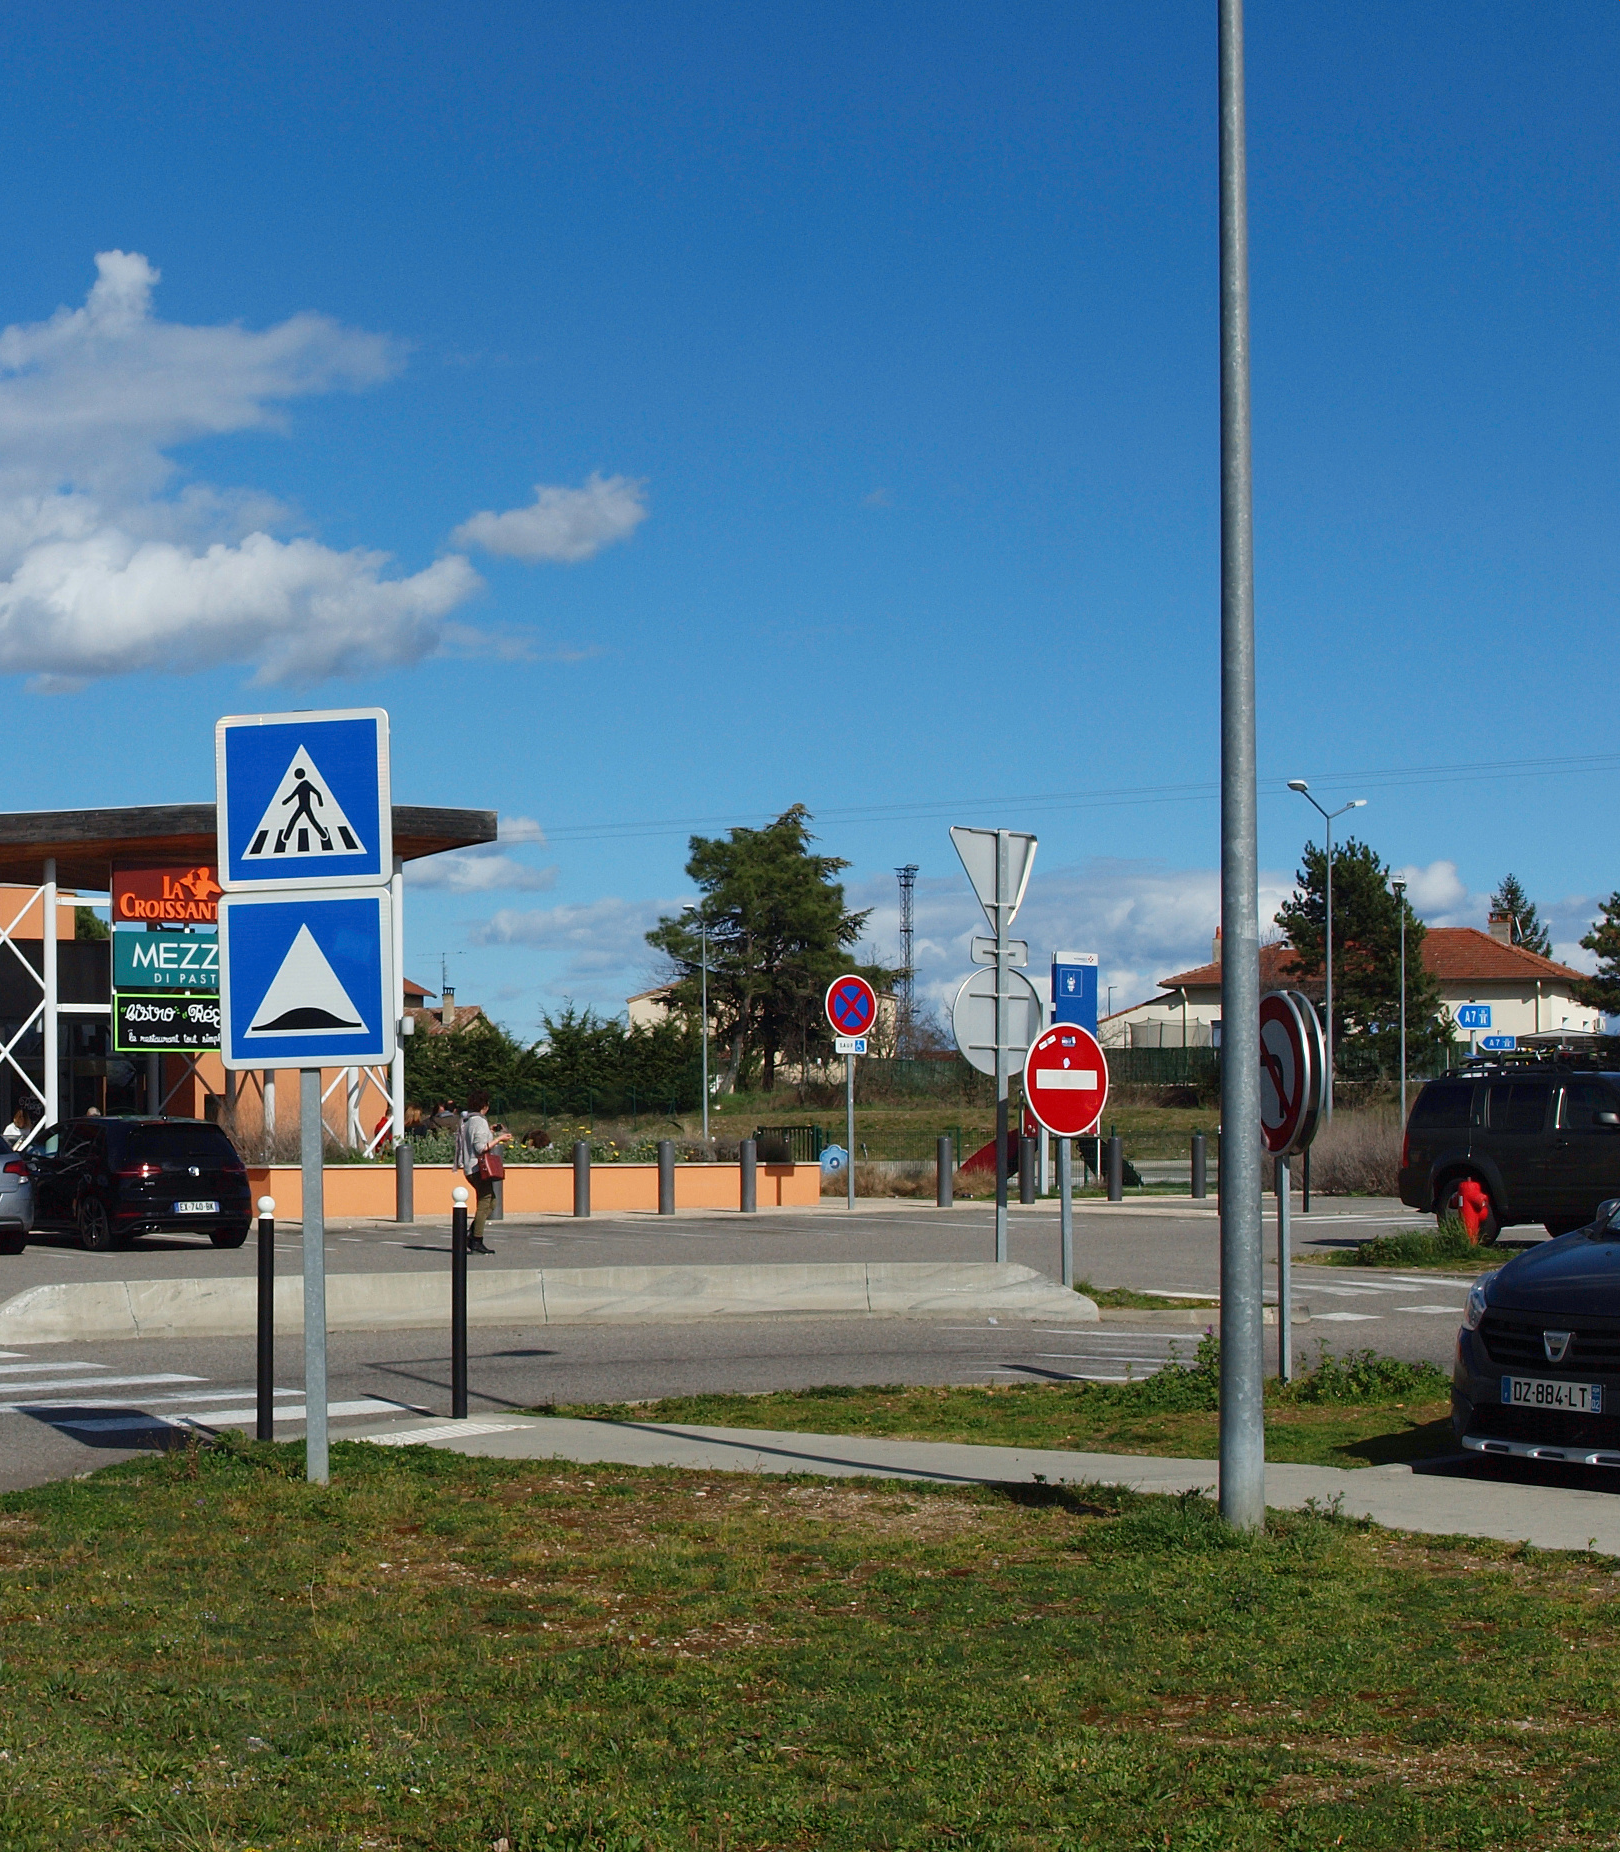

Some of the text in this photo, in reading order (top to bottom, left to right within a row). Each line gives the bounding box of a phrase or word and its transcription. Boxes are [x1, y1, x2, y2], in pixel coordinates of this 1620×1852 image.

[162, 875, 184, 900] LA
[120, 892, 218, 920] CROISSANT
[132, 942, 219, 970] MEZZ
[154, 972, 217, 985] DI PAST
[124, 1003, 220, 1028] bistro Rég
[183, 1033, 198, 1044] tout
[1513, 1380, 1588, 1408] DZ-884-LT
